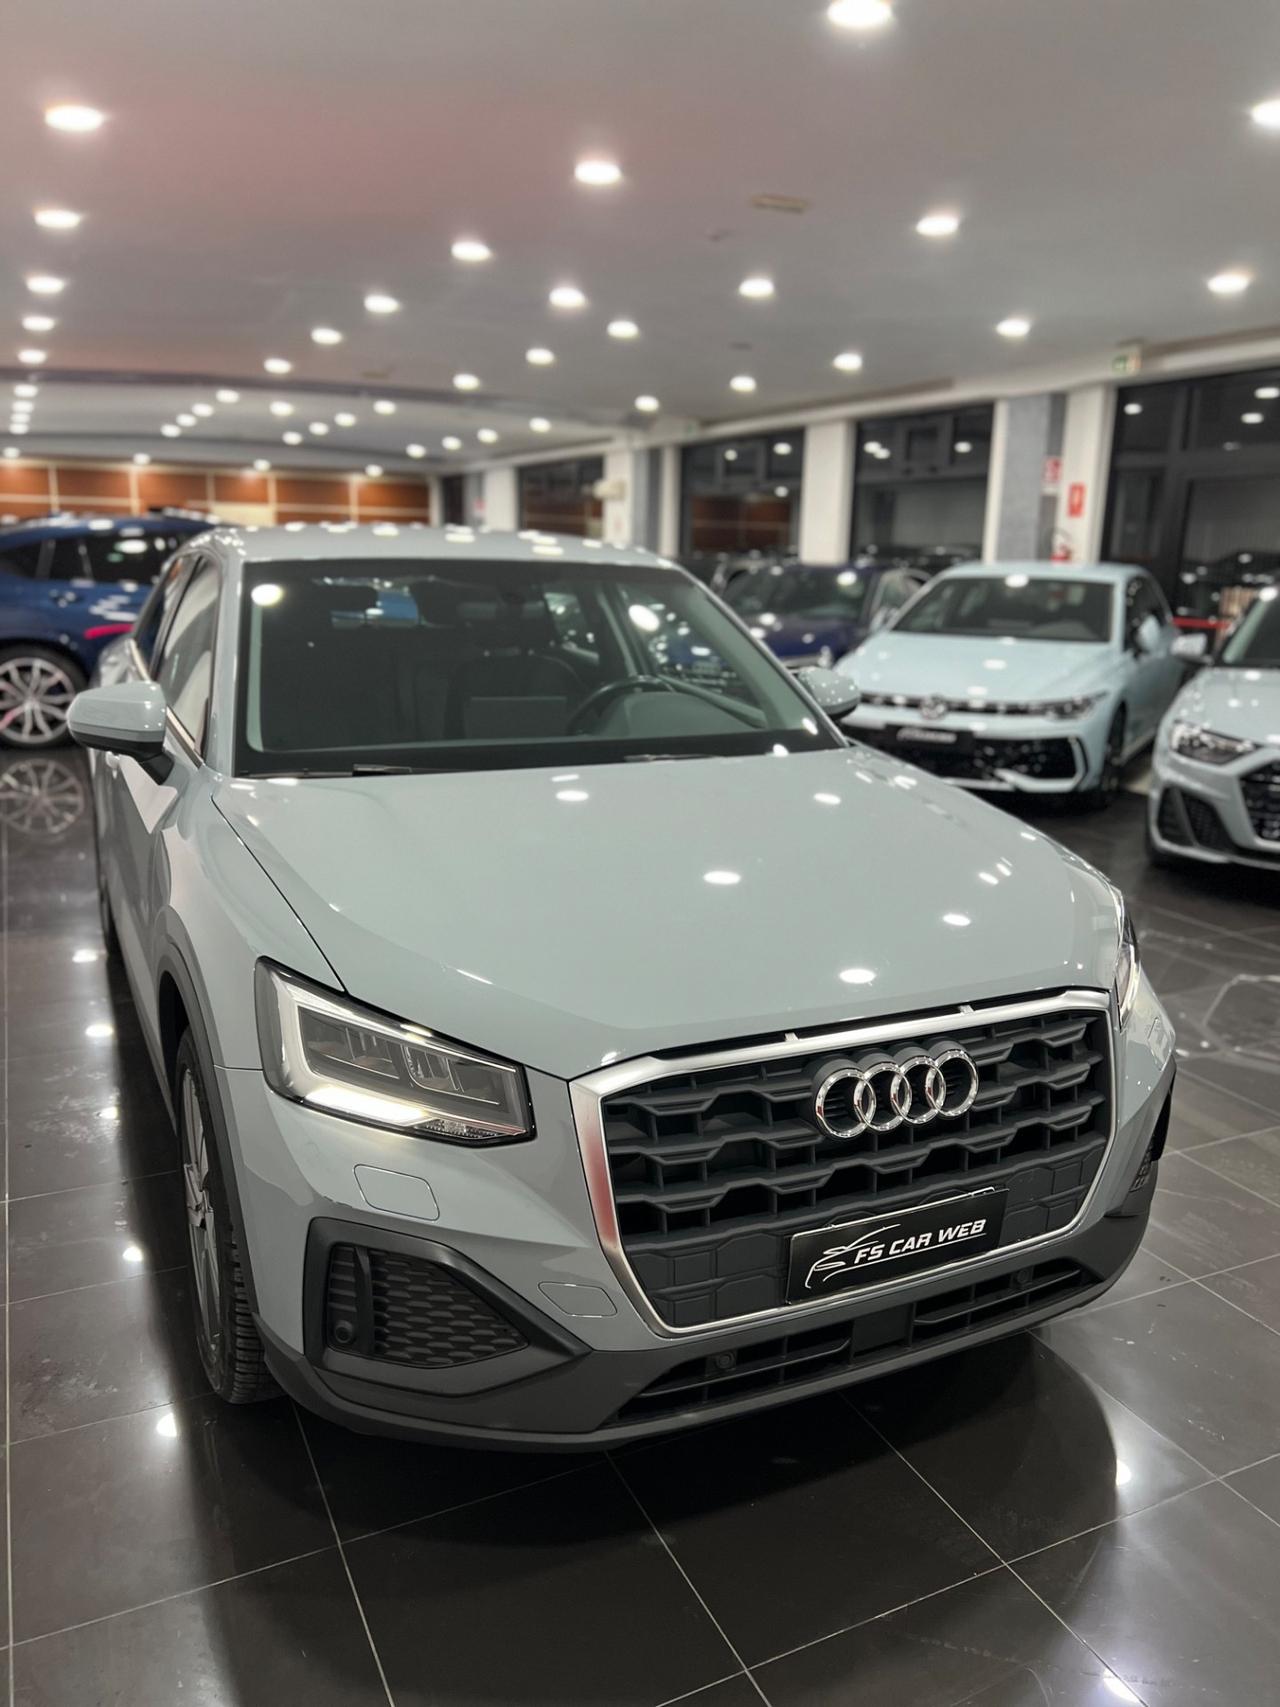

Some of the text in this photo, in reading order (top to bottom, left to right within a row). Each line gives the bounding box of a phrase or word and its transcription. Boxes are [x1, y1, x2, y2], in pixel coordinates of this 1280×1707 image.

[855, 1219, 986, 1264] FS CAR WEB
